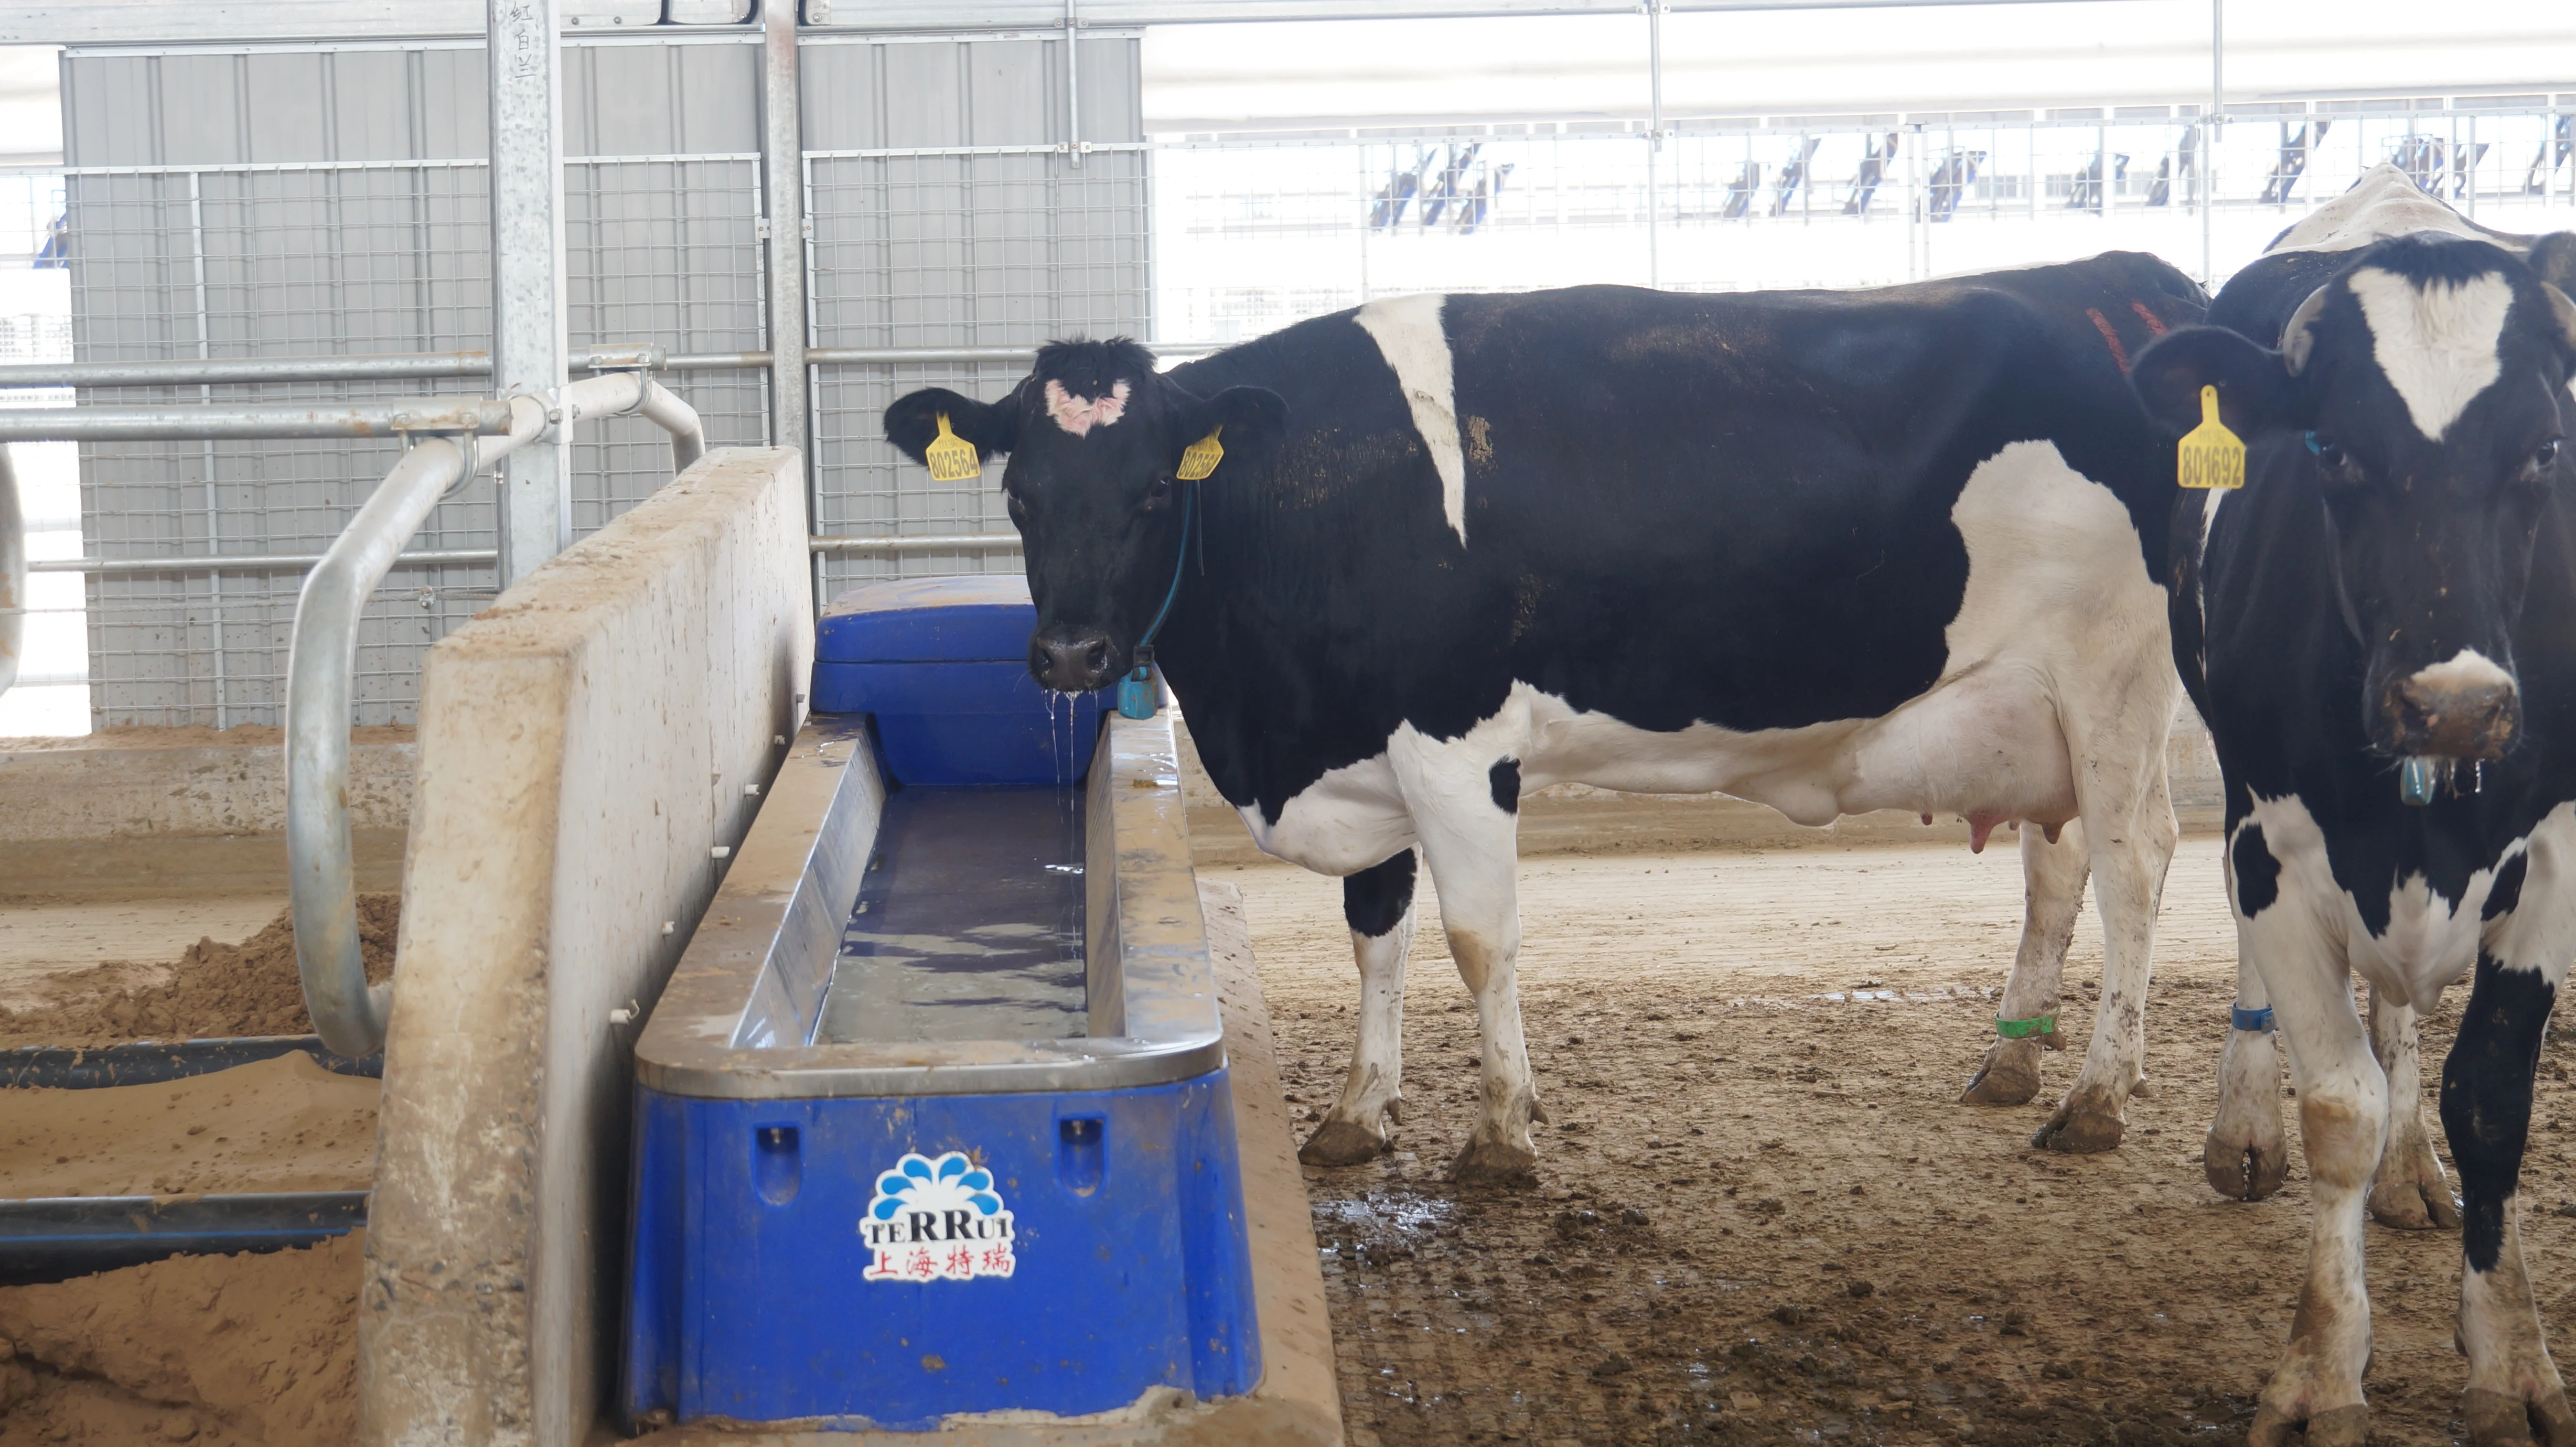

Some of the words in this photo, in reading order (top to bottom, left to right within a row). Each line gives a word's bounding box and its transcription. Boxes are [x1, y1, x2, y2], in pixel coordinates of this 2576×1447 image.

[929, 448, 979, 479] 802564
[2183, 446, 2241, 485] 801692
[870, 1243, 1011, 1277] 上海特瑞
